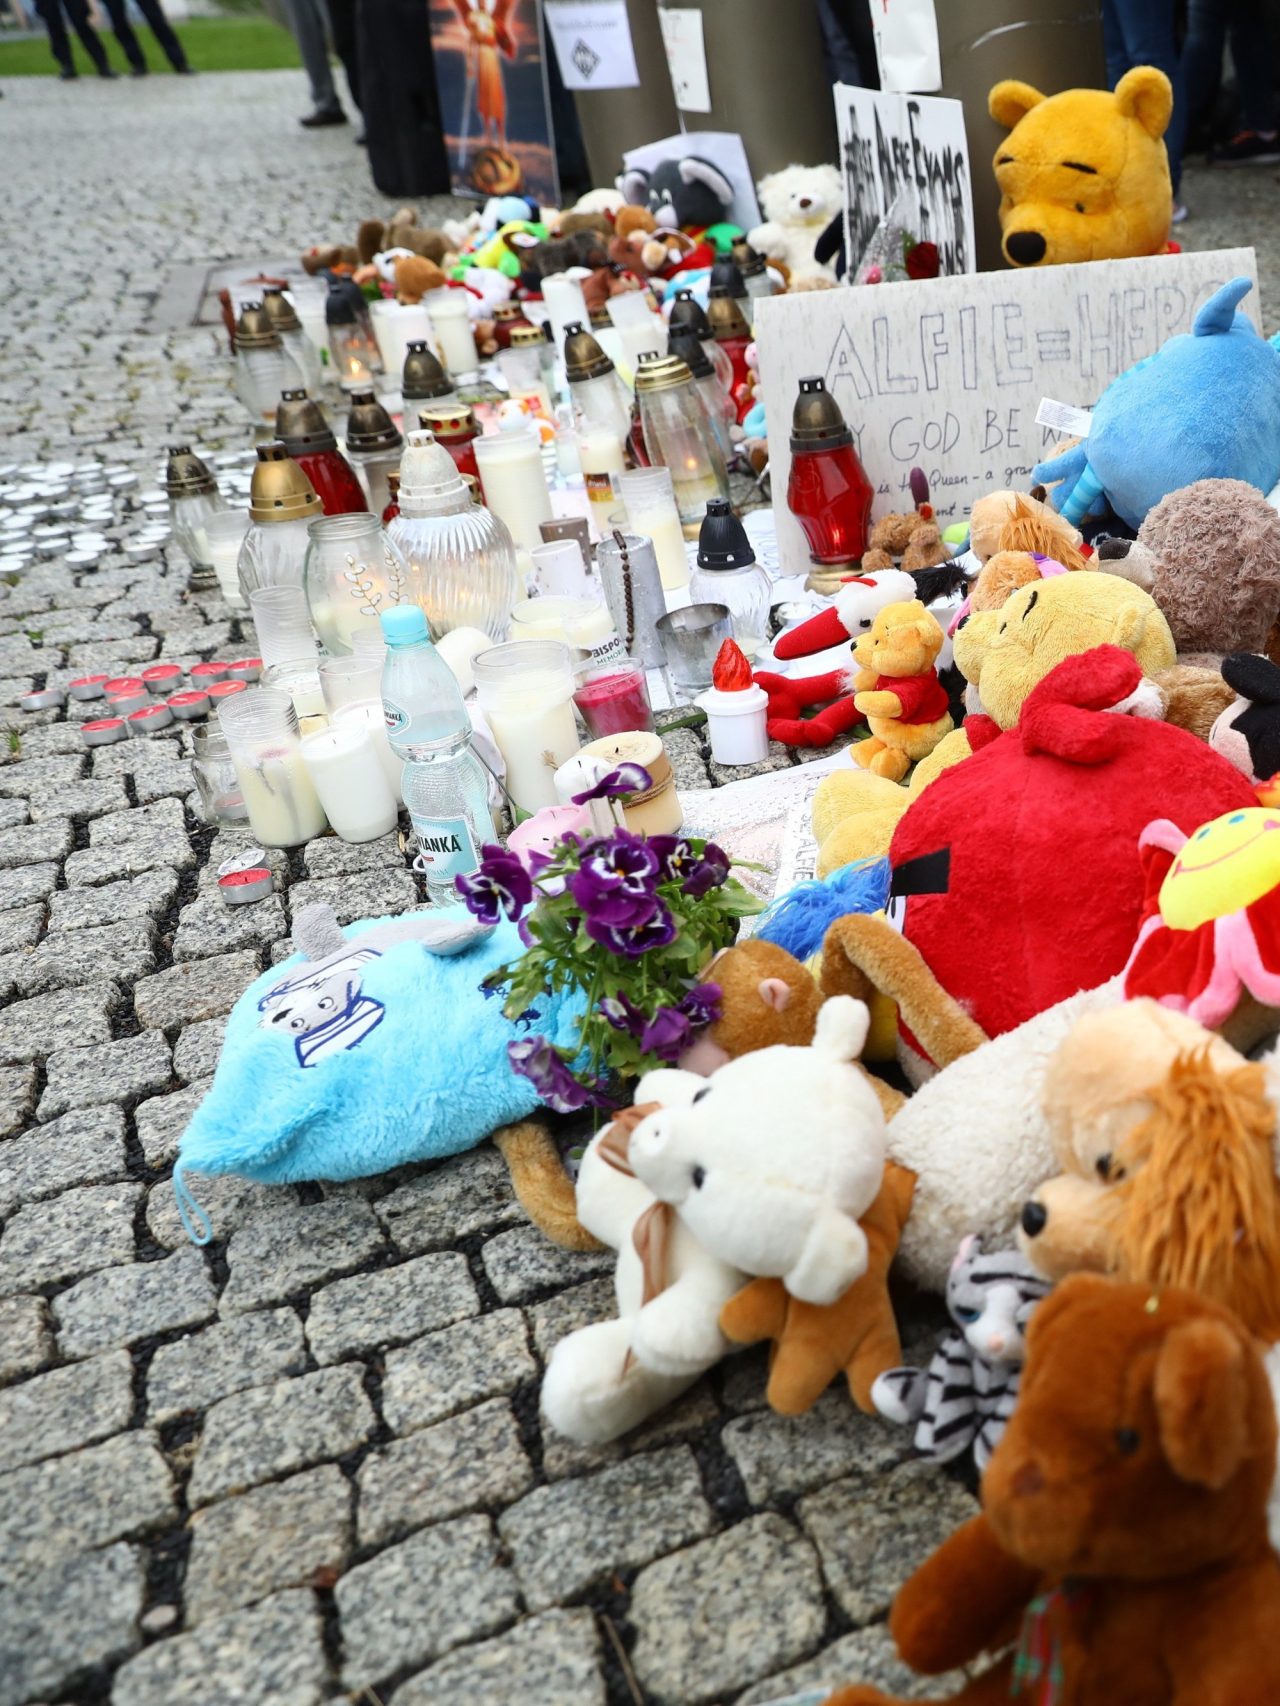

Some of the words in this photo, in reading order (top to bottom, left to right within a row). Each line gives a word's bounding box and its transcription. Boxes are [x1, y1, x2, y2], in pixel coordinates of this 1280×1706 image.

[907, 100, 964, 208] EVANS
[889, 410, 961, 462] GOD
[979, 408, 1021, 454] BE
[876, 479, 890, 495] is
[928, 467, 969, 492] Queen
[984, 469, 994, 480] a
[1004, 459, 1042, 486] gran
[590, 637, 622, 659] BISPO
